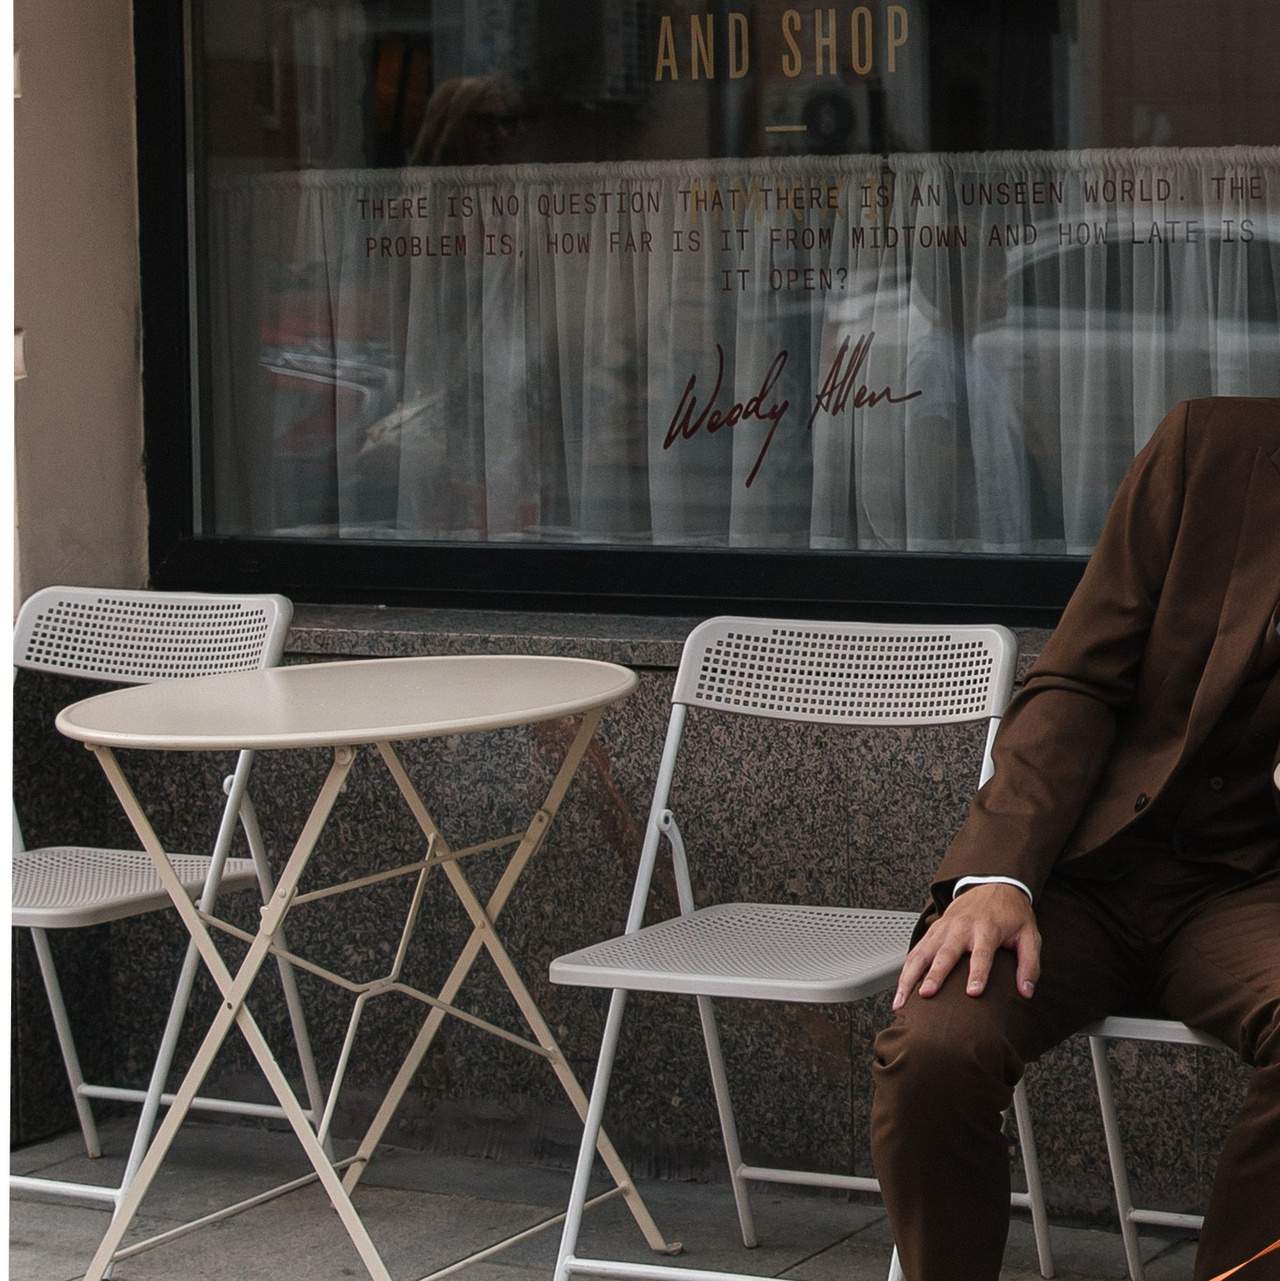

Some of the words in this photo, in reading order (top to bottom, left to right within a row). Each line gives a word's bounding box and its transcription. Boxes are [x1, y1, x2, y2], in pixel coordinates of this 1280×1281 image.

[654, 11, 751, 82] AND
[780, 4, 909, 78] SHOP
[357, 195, 430, 223] THERE
[447, 194, 476, 219] IS
[490, 192, 520, 218] NO
[537, 188, 661, 217] QUESTION
[678, 184, 742, 213] THAT
[758, 182, 841, 211] THERE
[859, 181, 891, 209] IS
[910, 179, 942, 208] AN
[960, 175, 1065, 207] UNSEEN
[1082, 175, 1186, 204] WORLD.
[1211, 173, 1264, 201] THE
[365, 230, 468, 259] PROBLEM
[485, 227, 525, 260] IS,
[545, 225, 591, 256] HOW
[608, 224, 654, 253] FAR
[672, 223, 702, 251] IS
[720, 222, 750, 250] IT
[769, 220, 834, 250] FROM
[851, 220, 968, 249] MIDTOWN
[988, 219, 1038, 246] AND
[1057, 218, 1108, 245] HOW
[1131, 216, 1199, 245] LATE
[1220, 215, 1255, 243] IS
[720, 267, 750, 294] IT
[769, 265, 848, 293] OPEN?
[662, 342, 790, 488] Woody
[806, 331, 922, 431] Allen
